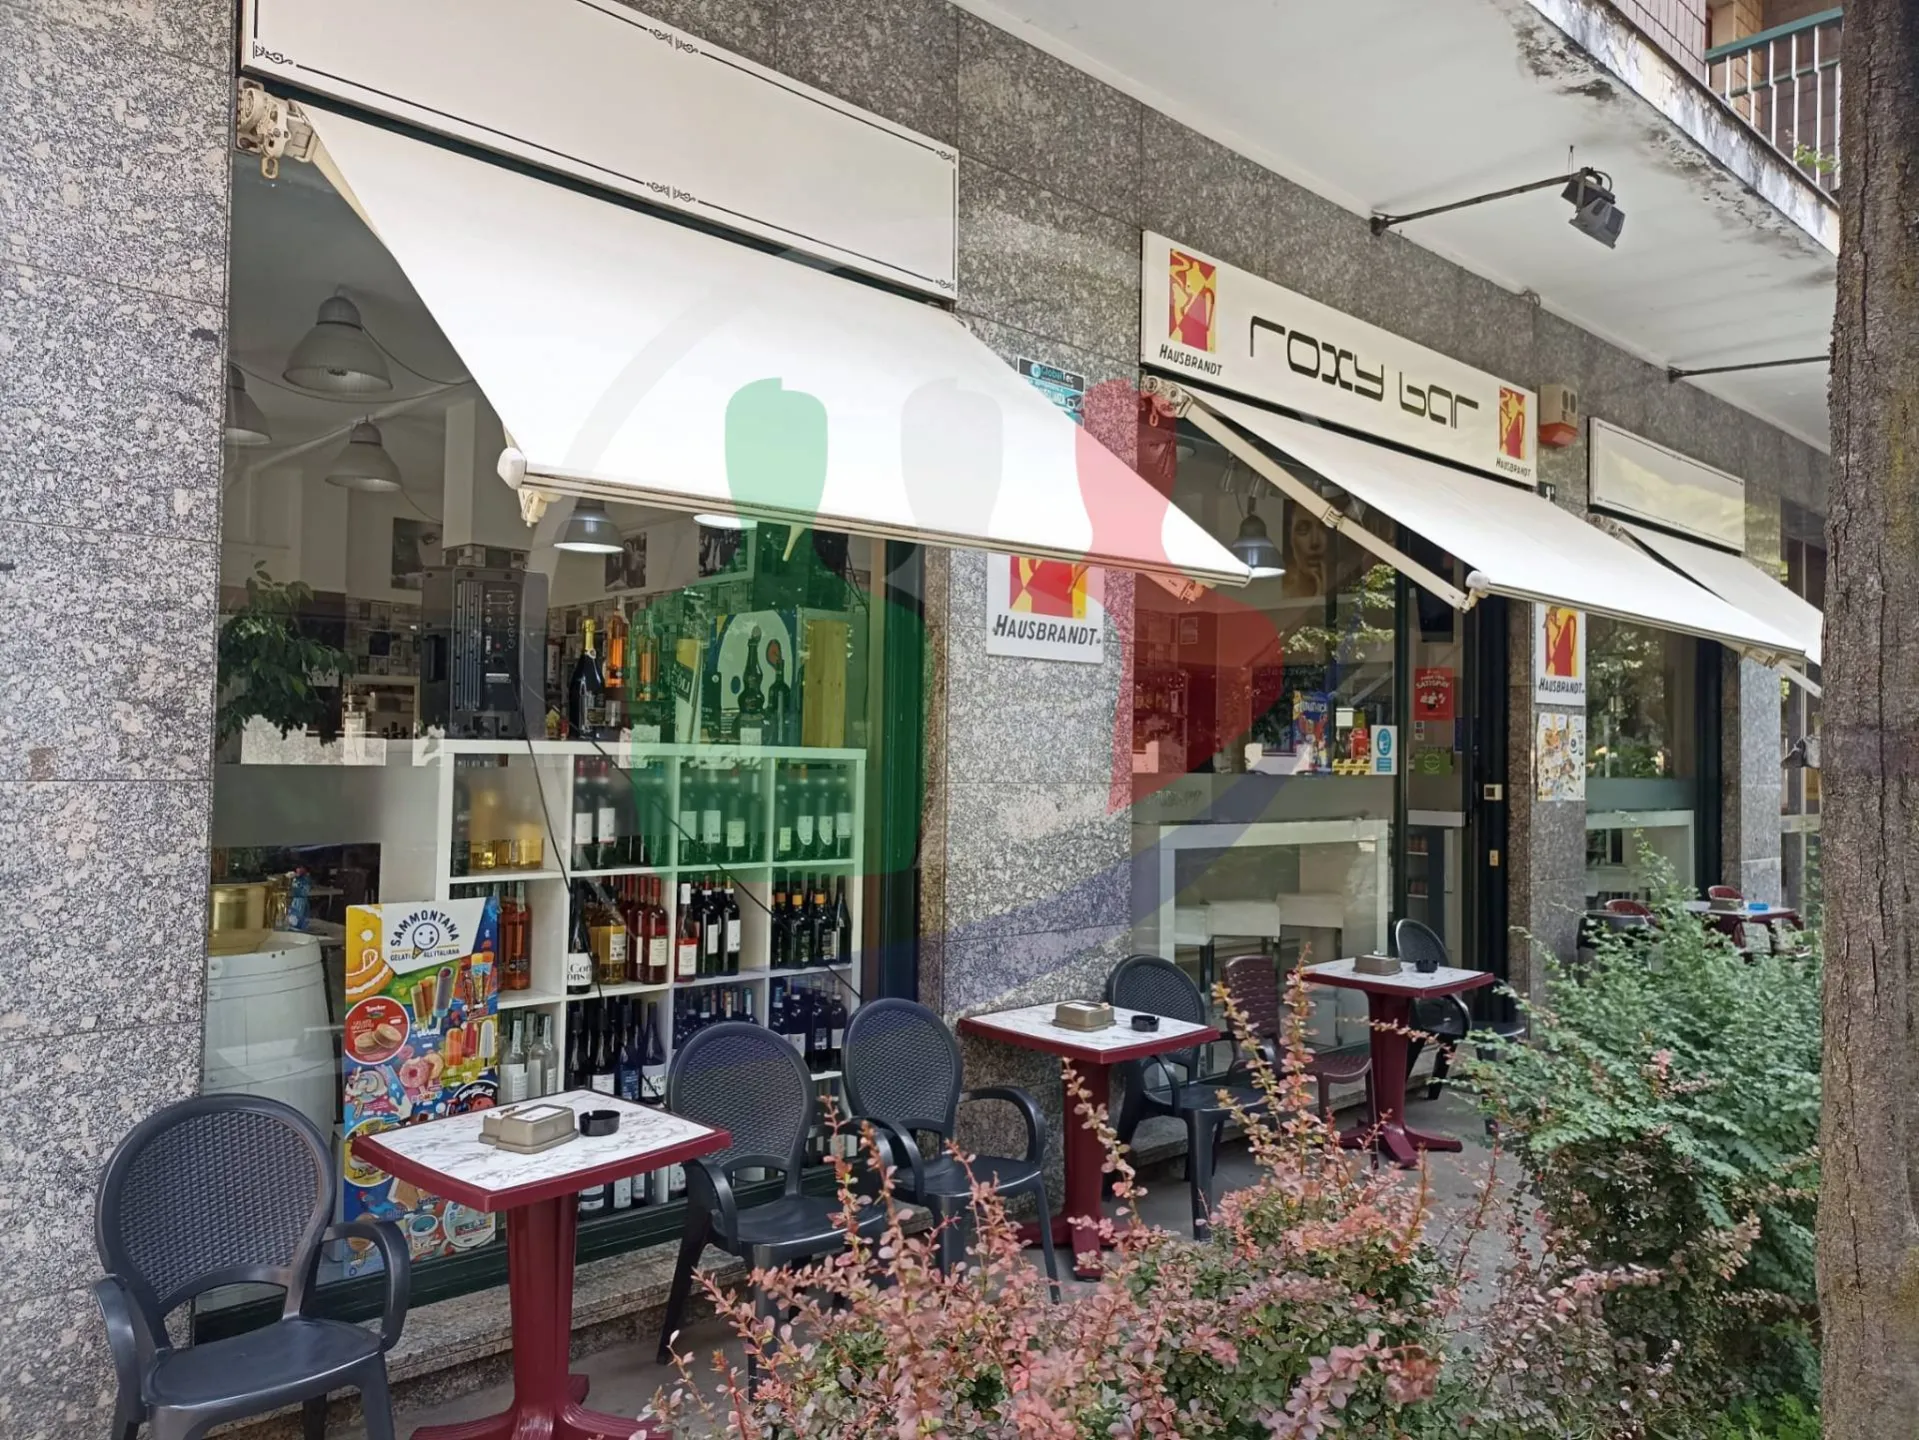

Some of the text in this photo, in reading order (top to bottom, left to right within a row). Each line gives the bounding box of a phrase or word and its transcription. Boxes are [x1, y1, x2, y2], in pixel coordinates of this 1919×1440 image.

[1159, 343, 1222, 376] HAUSBRANDT
[1249, 315, 1479, 429] roxy bar
[992, 614, 1098, 646] HAUSBRANDT
[1539, 676, 1583, 695] HAUSBRANDT
[390, 909, 460, 947] SAMMONTANA
